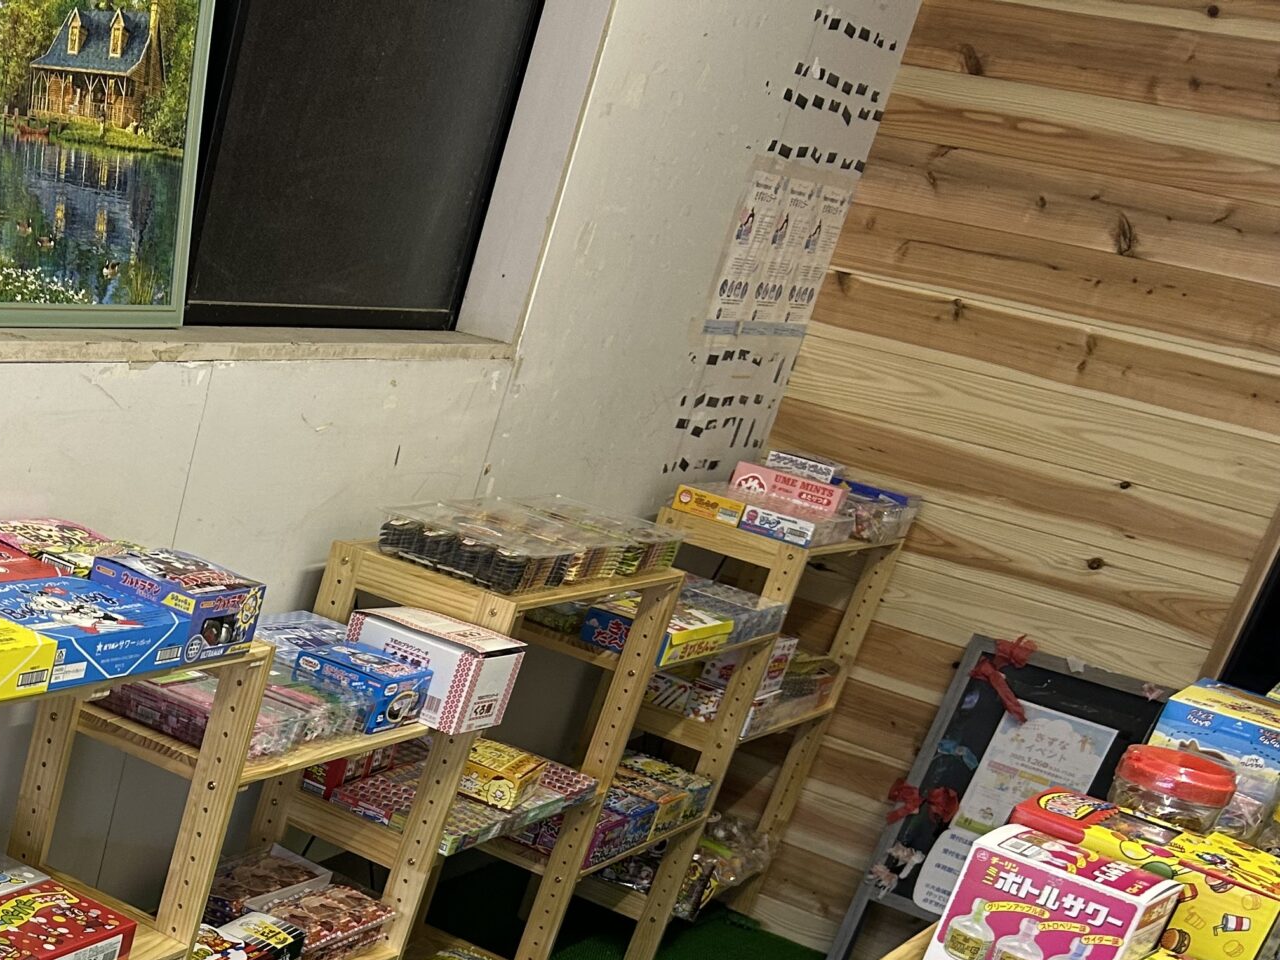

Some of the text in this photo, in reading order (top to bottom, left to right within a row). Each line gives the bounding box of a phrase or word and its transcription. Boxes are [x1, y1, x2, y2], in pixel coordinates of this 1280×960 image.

[774, 474, 834, 498] UME MINTS
[120, 571, 162, 594] ウルトラマン
[1025, 744, 1067, 763] イベント
[990, 856, 1019, 873] チーリン
[993, 871, 1124, 928] ボトルサワー
[986, 902, 1047, 918] グリーンアップル味
[1040, 921, 1089, 934] ストロベリー味
[1083, 935, 1121, 946] サイダー味
